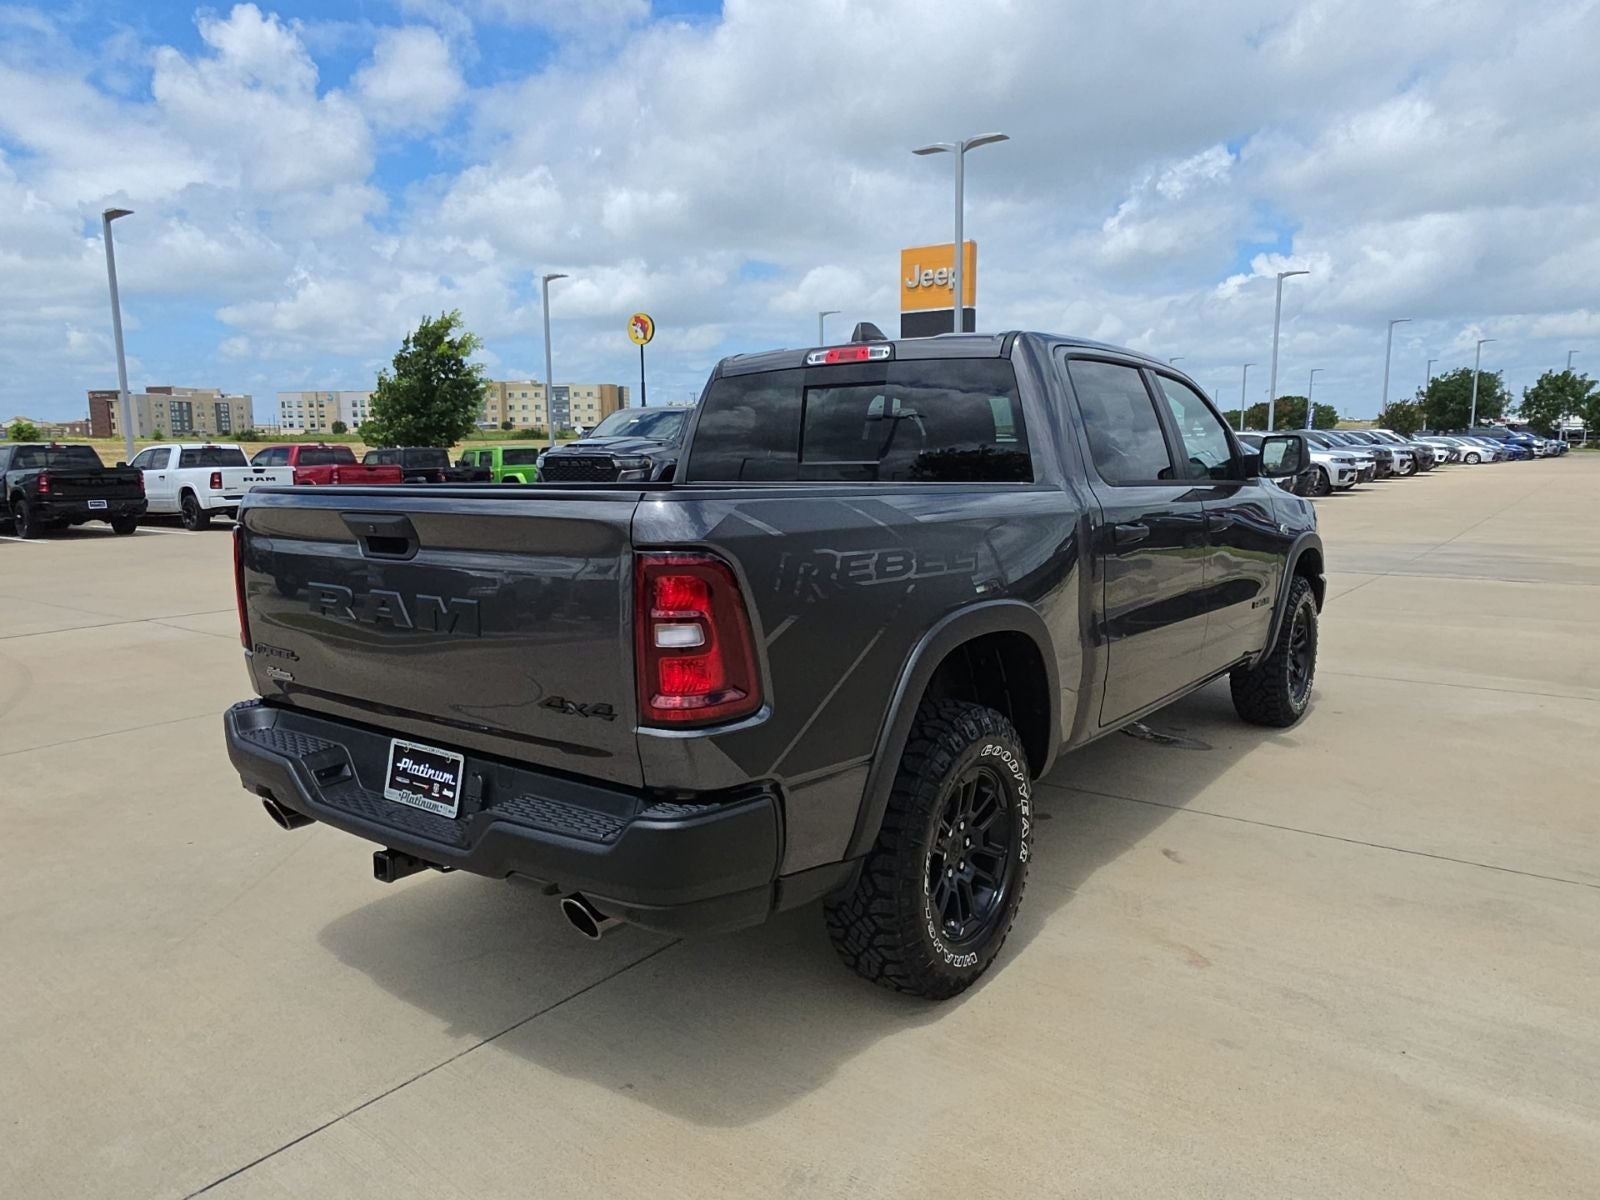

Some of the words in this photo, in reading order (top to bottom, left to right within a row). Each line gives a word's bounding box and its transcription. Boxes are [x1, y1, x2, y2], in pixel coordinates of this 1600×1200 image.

[308, 581, 482, 637] RAM
[396, 758, 456, 785] Platinum
[400, 791, 441, 812] Platinum
[980, 744, 1030, 863] GOODYEAR
